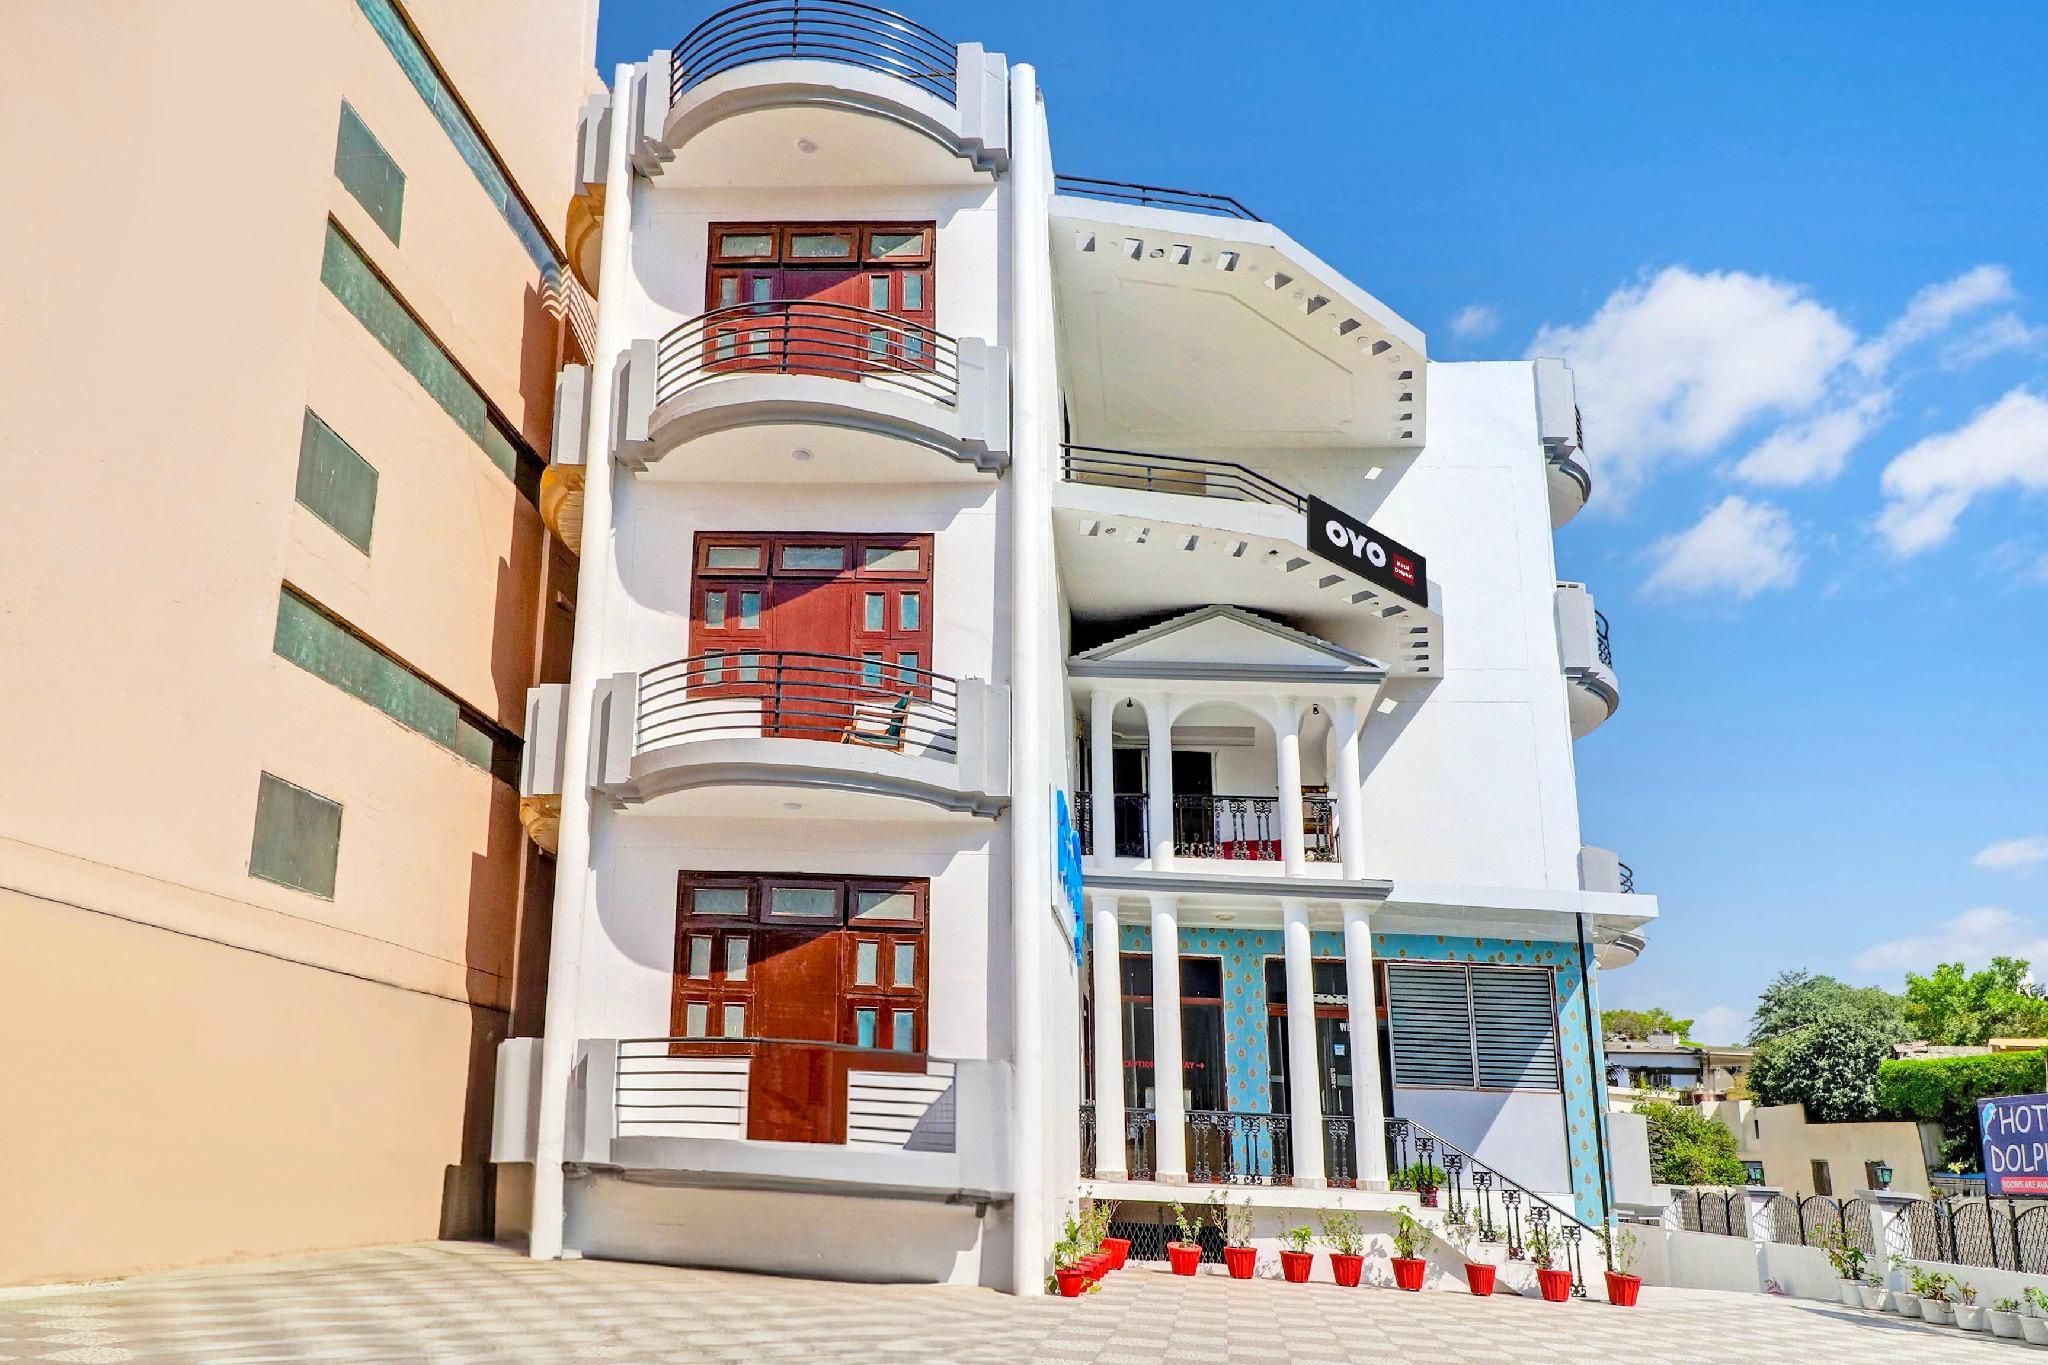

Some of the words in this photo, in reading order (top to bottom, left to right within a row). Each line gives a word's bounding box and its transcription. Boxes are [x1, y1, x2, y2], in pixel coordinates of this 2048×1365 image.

[1325, 520, 1387, 567] OYO
[1184, 1061, 1195, 1069] AY
[1999, 1104, 2048, 1135] HOT
[1990, 1143, 2048, 1173] DOLP
